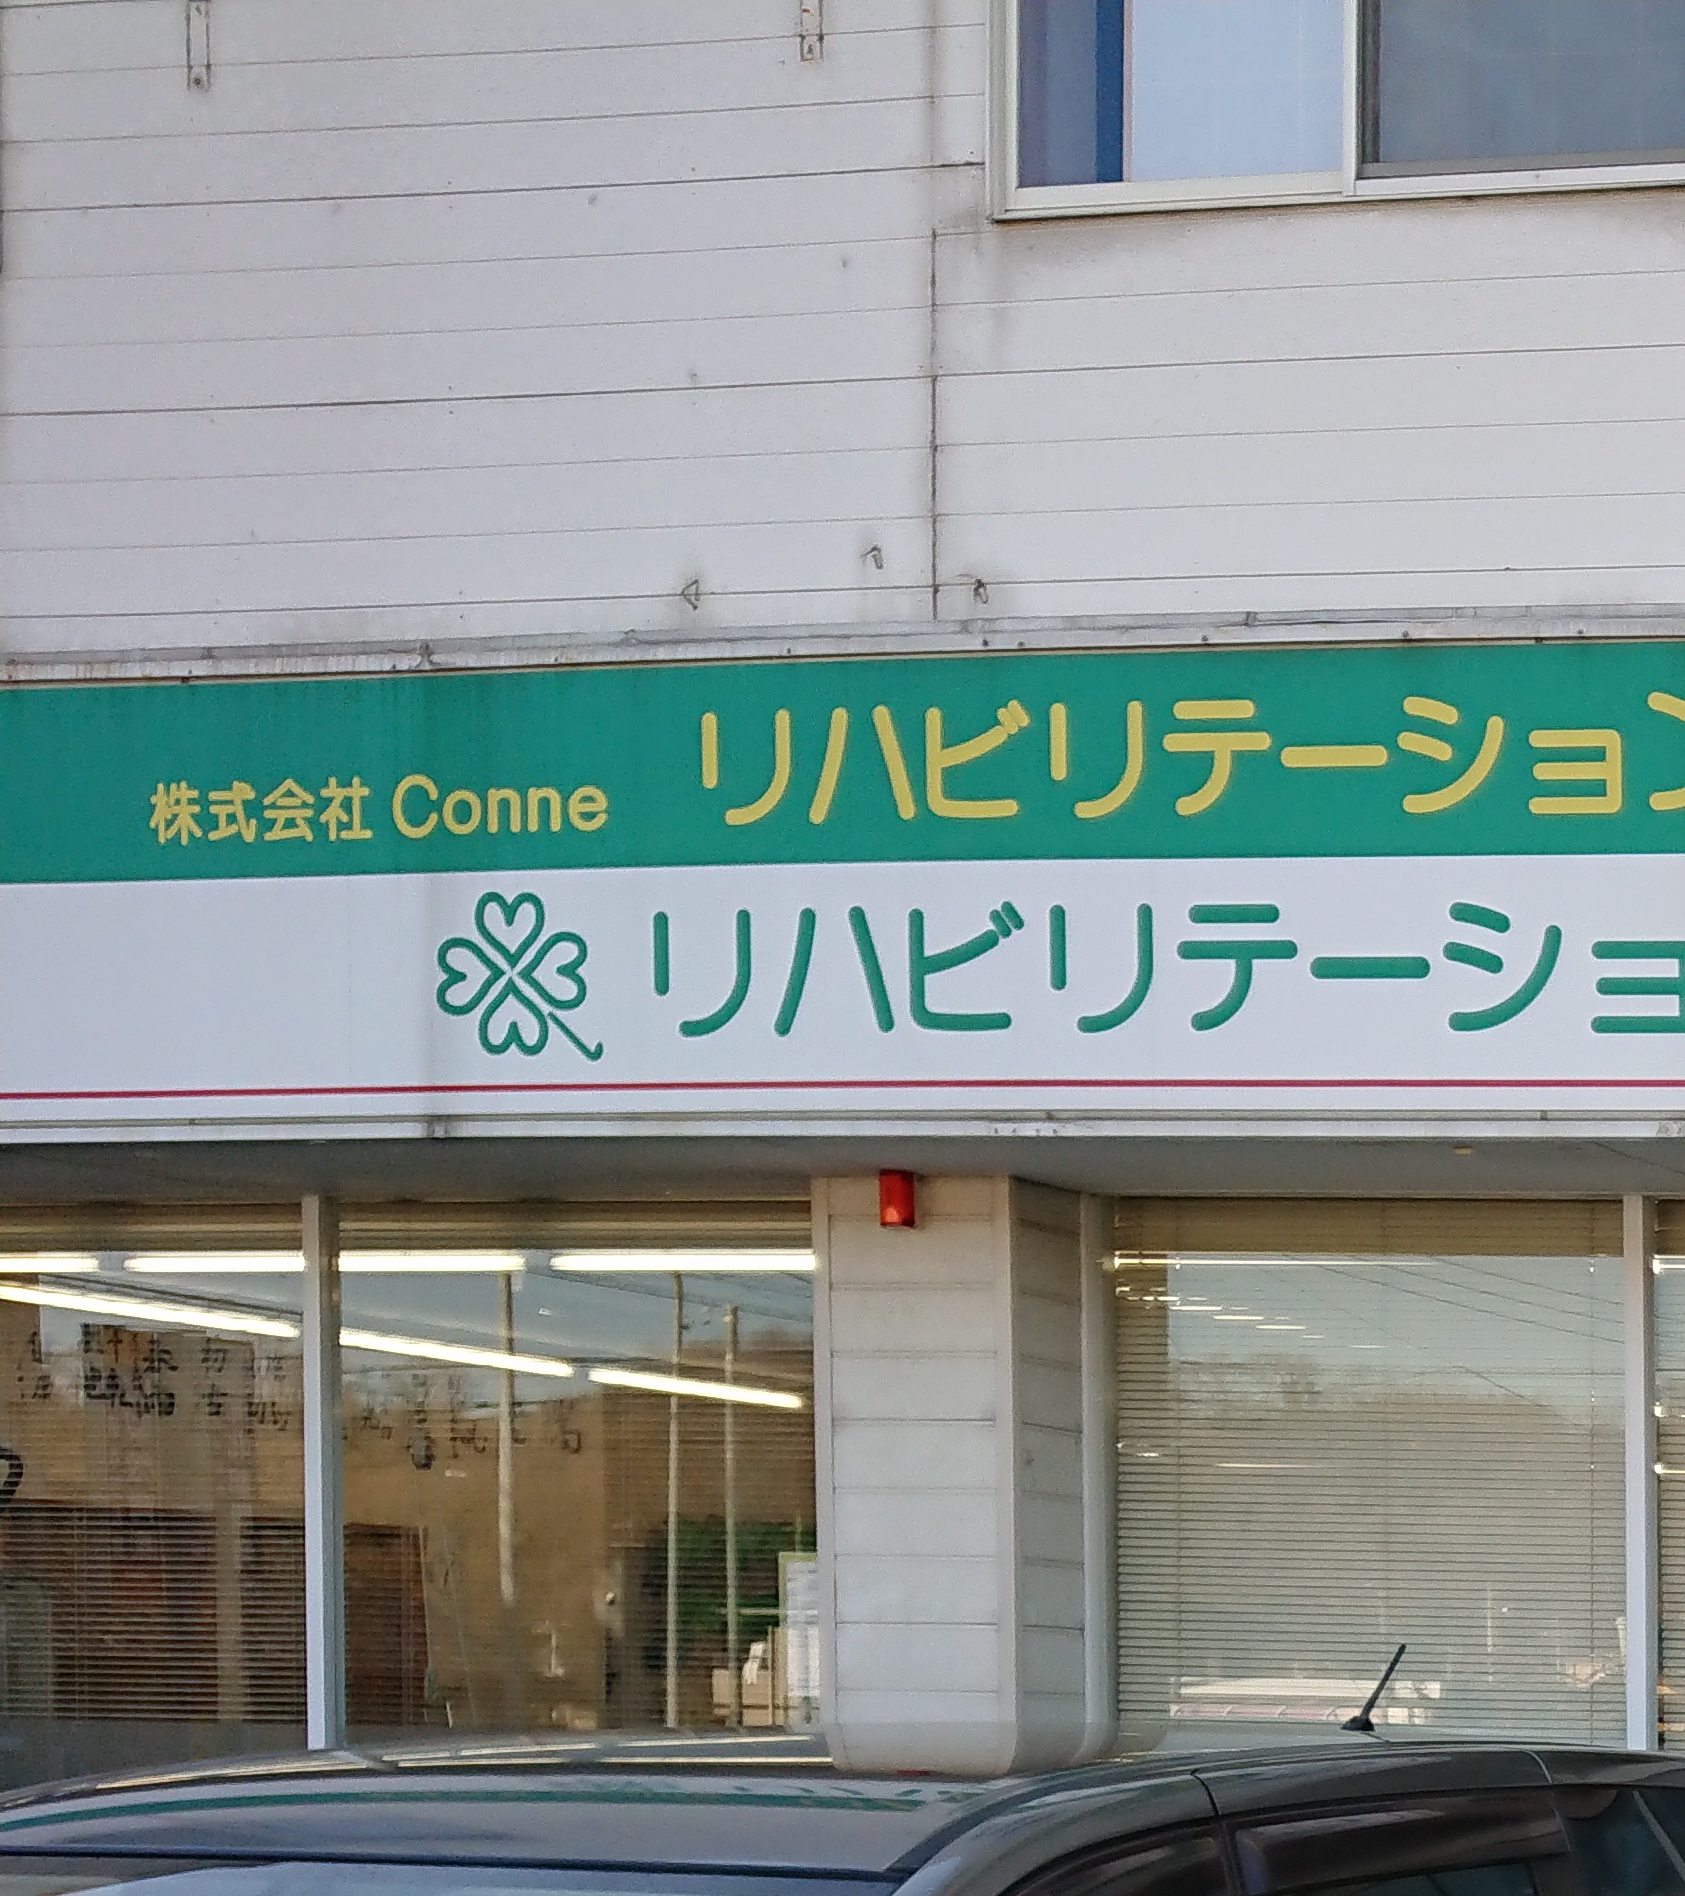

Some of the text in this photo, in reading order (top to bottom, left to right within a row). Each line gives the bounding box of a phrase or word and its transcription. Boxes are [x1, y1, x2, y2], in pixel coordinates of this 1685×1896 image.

[150, 774, 608, 844] 株式会社 Conne
